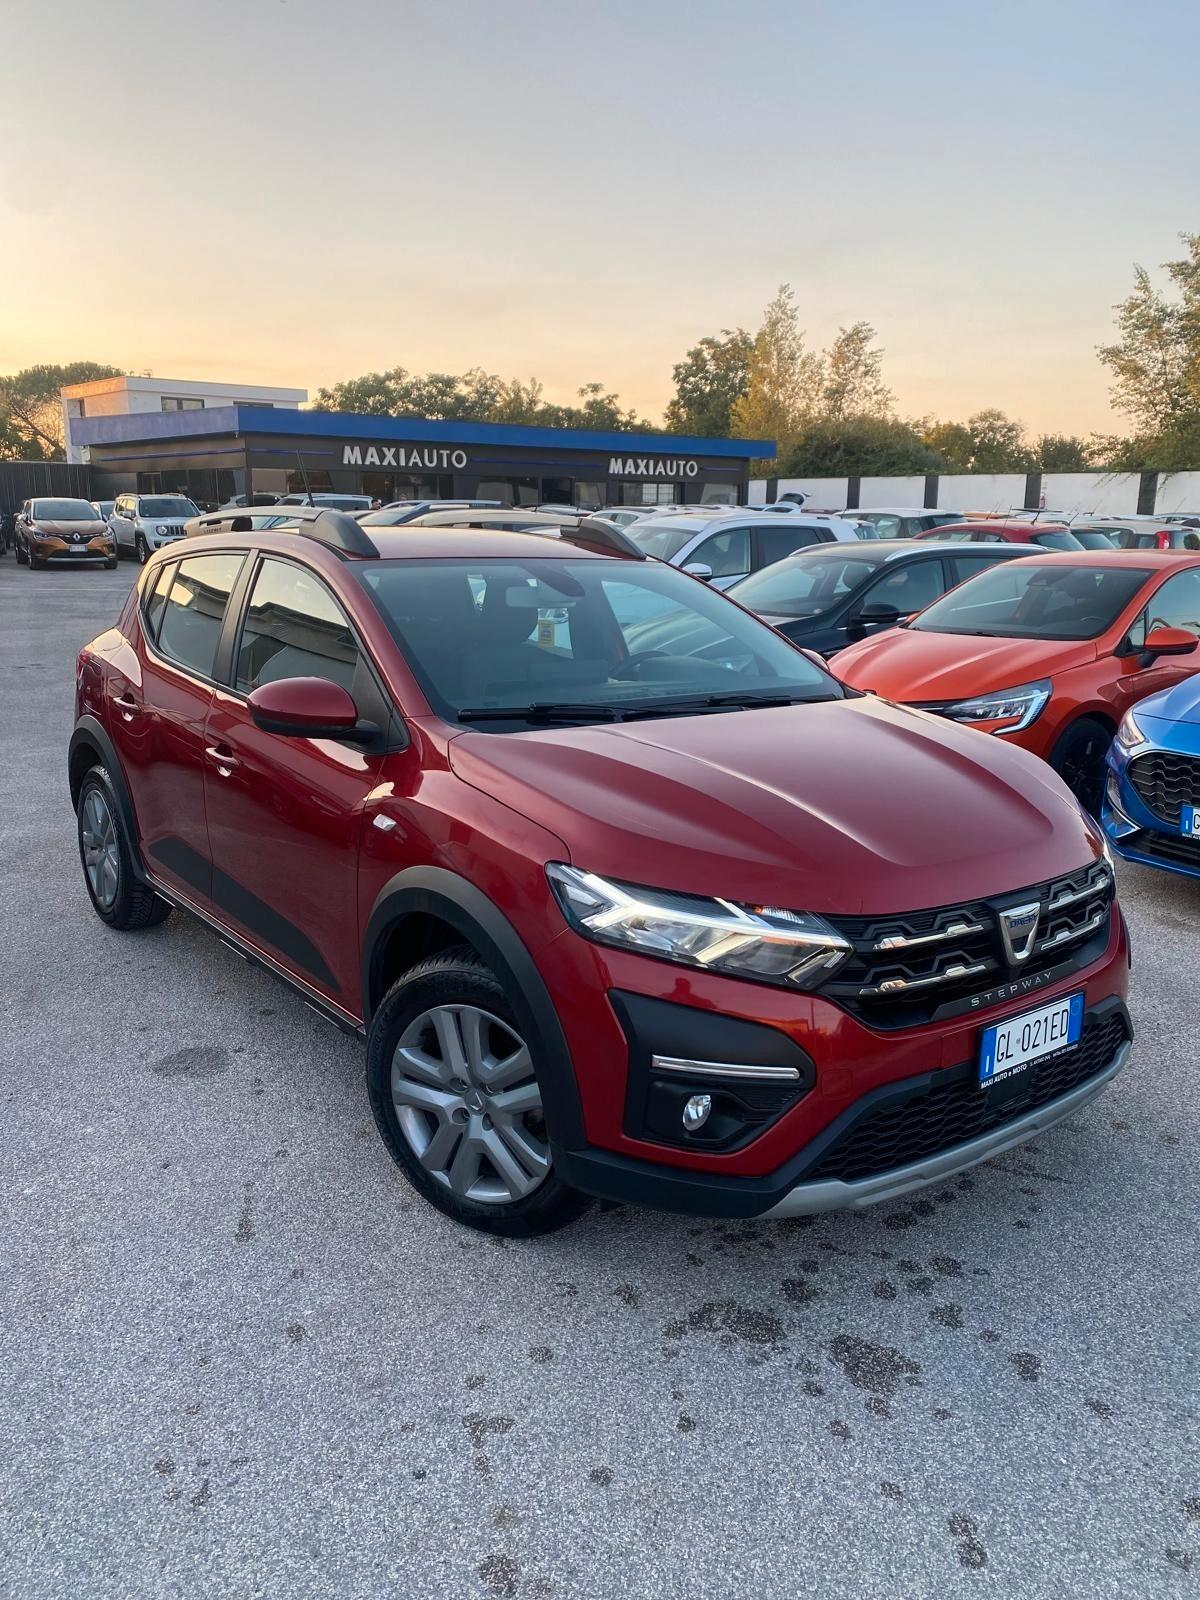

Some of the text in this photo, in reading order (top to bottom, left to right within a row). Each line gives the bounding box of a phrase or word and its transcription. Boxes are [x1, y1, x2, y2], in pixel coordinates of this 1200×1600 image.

[342, 446, 467, 468] MAXIAUTO
[608, 458, 698, 476] MAXIAUTO
[971, 971, 1052, 1007] STEPWAY
[981, 1079, 994, 1089] MAXI
[994, 1071, 1008, 1083] AUTO
[1012, 1063, 1028, 1075] MOTO
